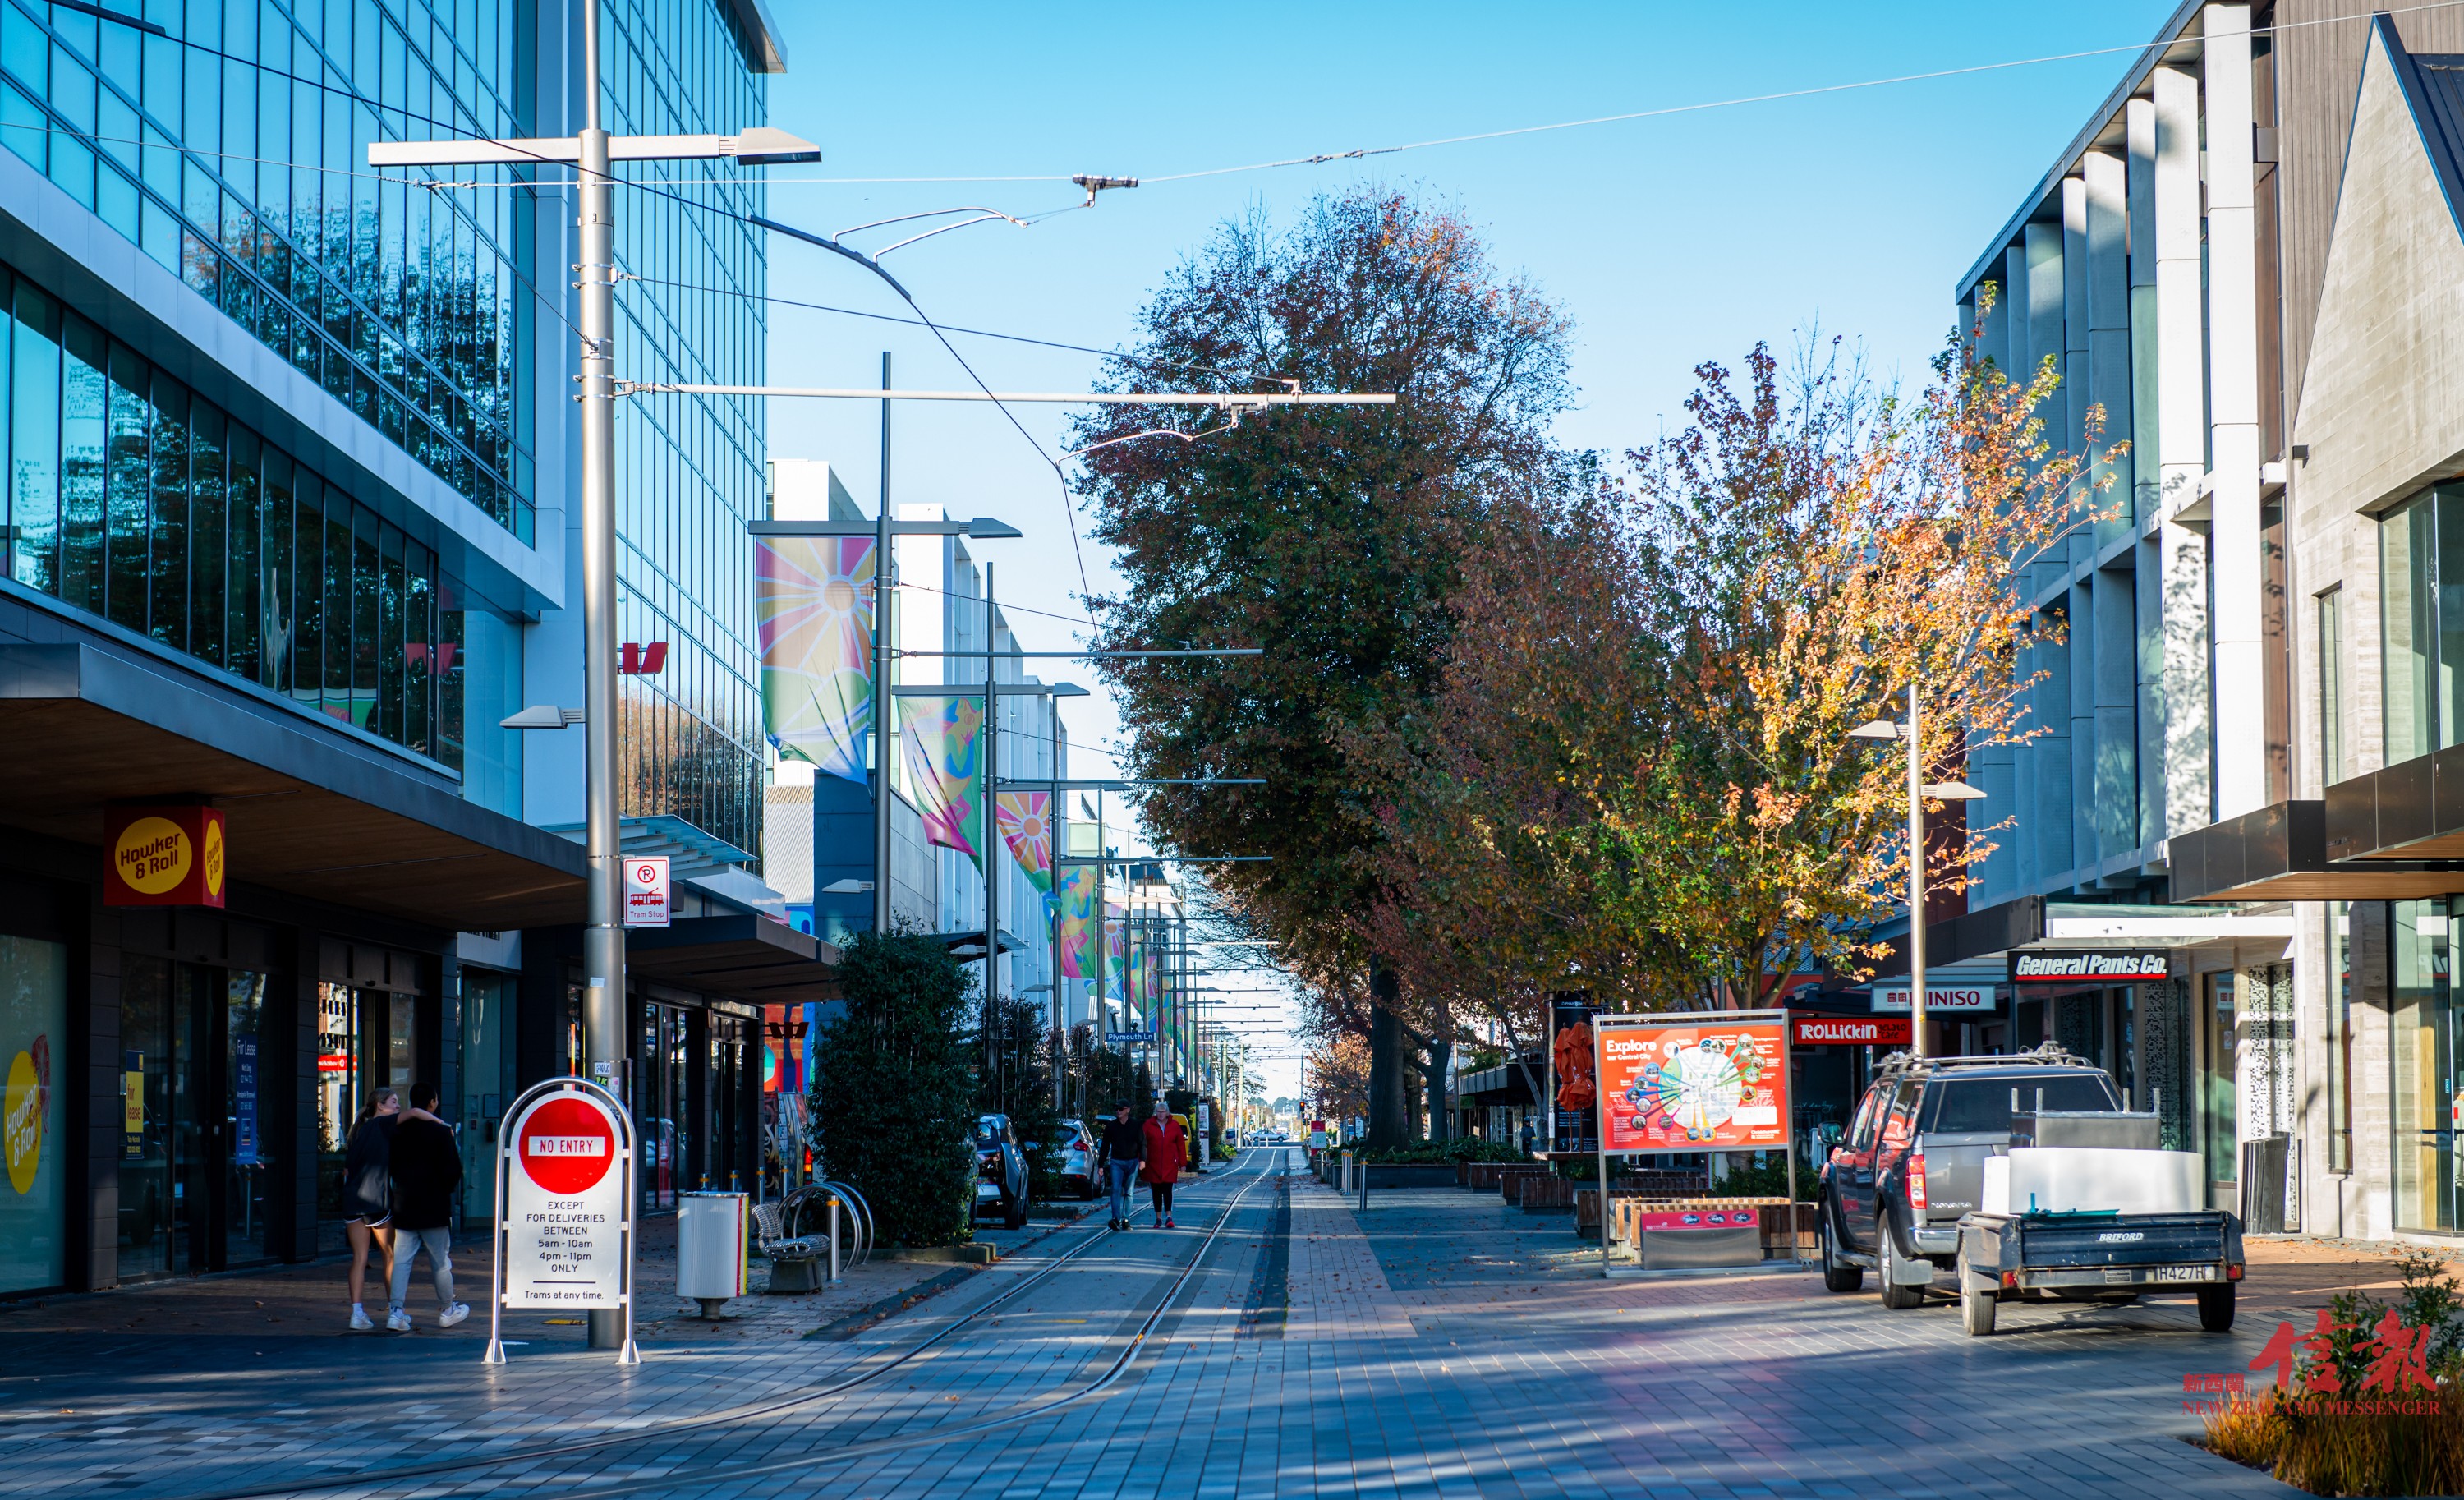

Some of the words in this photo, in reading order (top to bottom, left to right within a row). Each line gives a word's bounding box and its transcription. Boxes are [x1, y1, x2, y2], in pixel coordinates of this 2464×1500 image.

[149, 849, 178, 874] Roll
[648, 910, 664, 918] Stop
[2016, 954, 2089, 976] General
[2088, 955, 2139, 975] Pants
[2140, 954, 2167, 974] Co.
[1909, 991, 1980, 1006] INISO
[245, 1040, 256, 1056] Lease
[1606, 1038, 1657, 1055] Explore
[127, 1103, 140, 1120] lease
[21, 1120, 36, 1158] Roll
[540, 1139, 554, 1153] NO
[560, 1139, 593, 1153] ENTRY
[548, 1201, 585, 1209] EXCEPT
[526, 1213, 546, 1222] FOR
[549, 1214, 605, 1223] DELIVERIES
[544, 1226, 588, 1235] BETWEEN
[2099, 1232, 2144, 1242] BRIFORD
[538, 1239, 559, 1248] 5am
[568, 1239, 593, 1248] 10am
[539, 1251, 561, 1262] 4pm
[570, 1252, 591, 1262] 11pm
[551, 1263, 578, 1272] ONLY
[525, 1290, 551, 1299] Trams
[553, 1291, 562, 1300] at
[563, 1292, 581, 1301] any
[582, 1291, 604, 1300] time.
